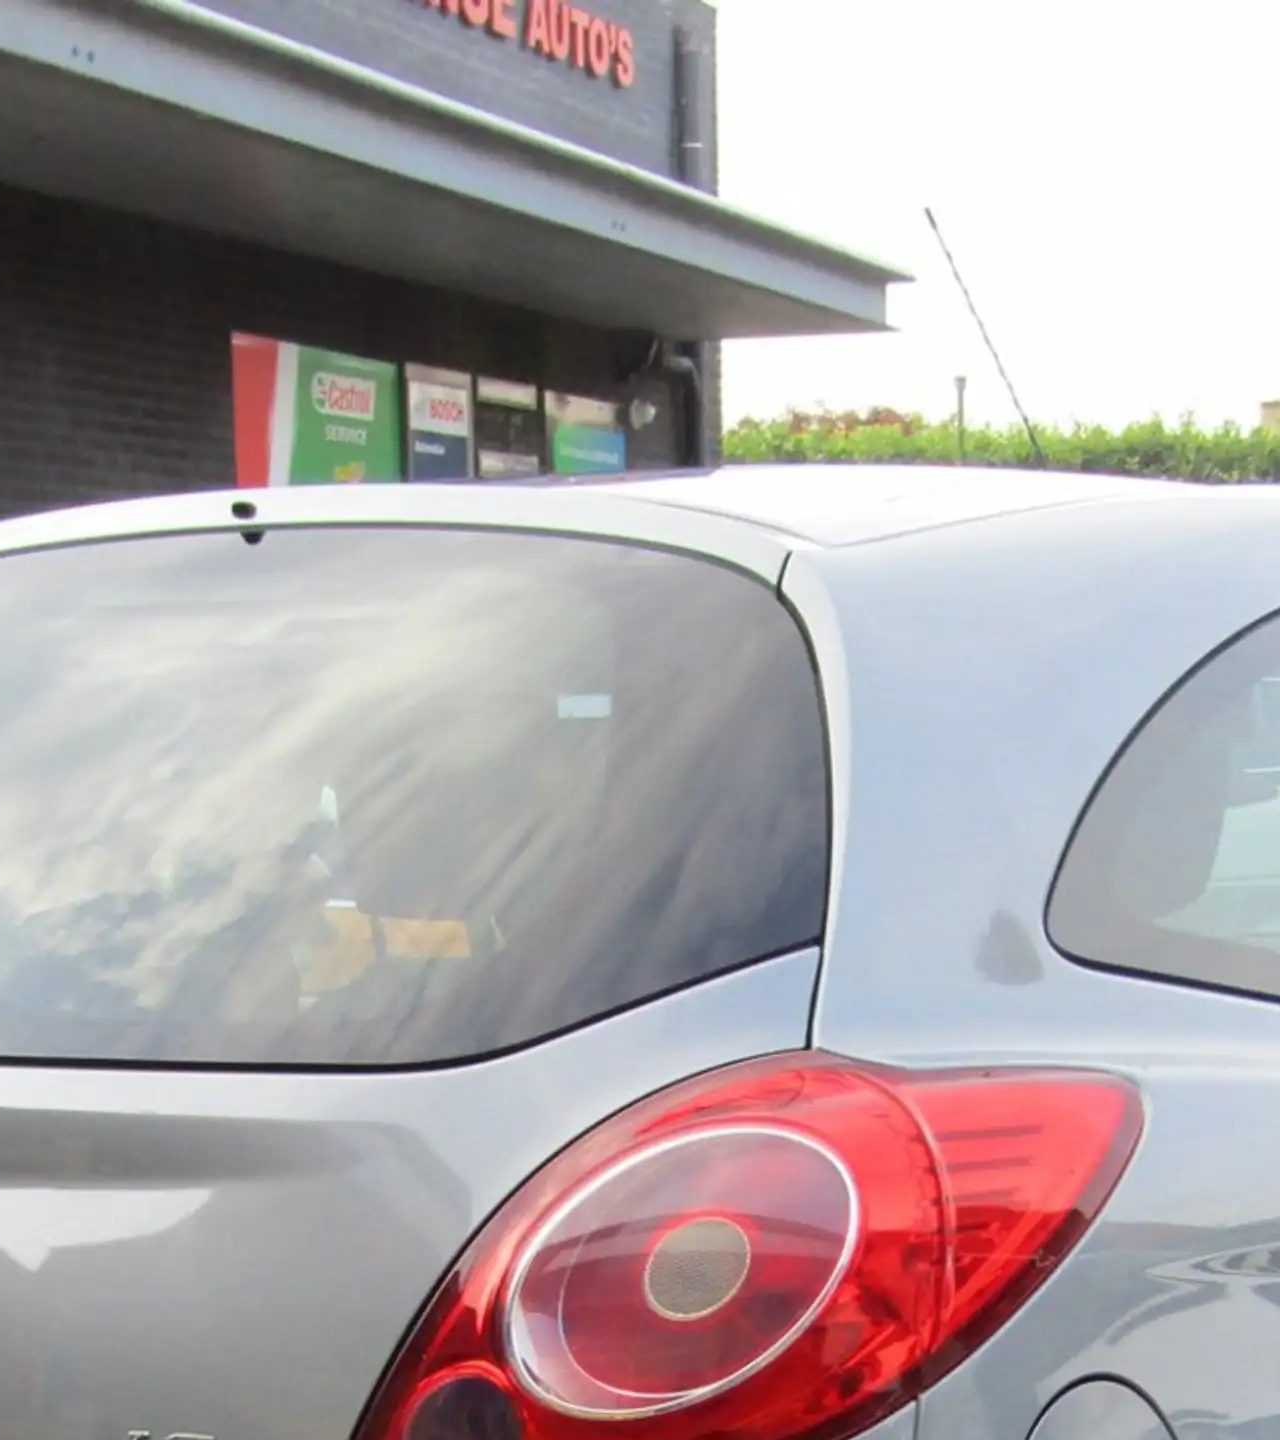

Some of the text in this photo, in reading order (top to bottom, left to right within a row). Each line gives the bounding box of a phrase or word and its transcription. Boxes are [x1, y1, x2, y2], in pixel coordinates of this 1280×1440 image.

[528, 0, 635, 88] AUTO'S
[328, 379, 372, 415] Castrol
[428, 397, 466, 423] BOSCH
[324, 423, 368, 446] SERVICE
